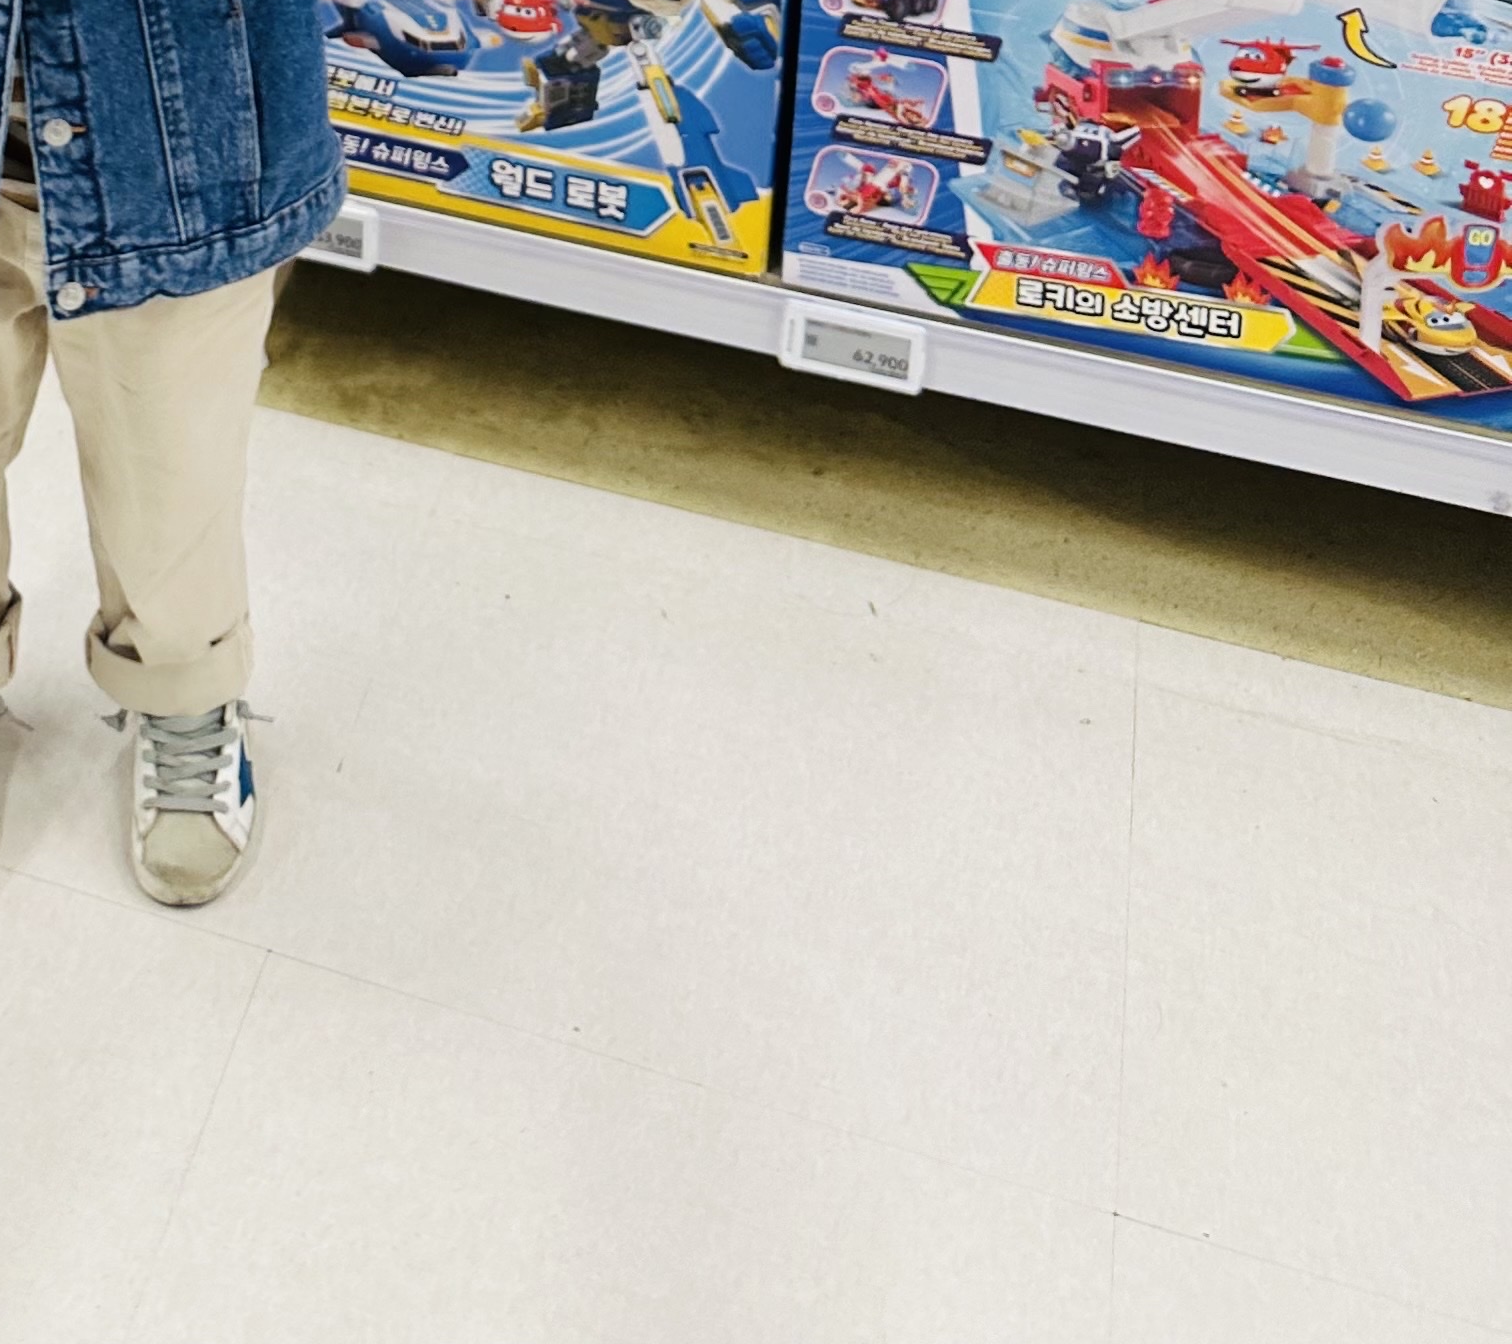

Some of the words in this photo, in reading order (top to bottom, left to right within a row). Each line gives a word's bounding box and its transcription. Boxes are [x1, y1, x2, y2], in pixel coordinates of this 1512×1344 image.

[371, 140, 452, 175] 슈퍼윙스
[489, 157, 555, 201] 월드
[565, 176, 630, 221] 로봇
[1468, 228, 1494, 248] GO
[1040, 255, 1111, 282] 슈퍼윙스
[1016, 278, 1105, 318] 로키의
[1111, 293, 1243, 339] 소방센터
[851, 348, 909, 373] 62,900
